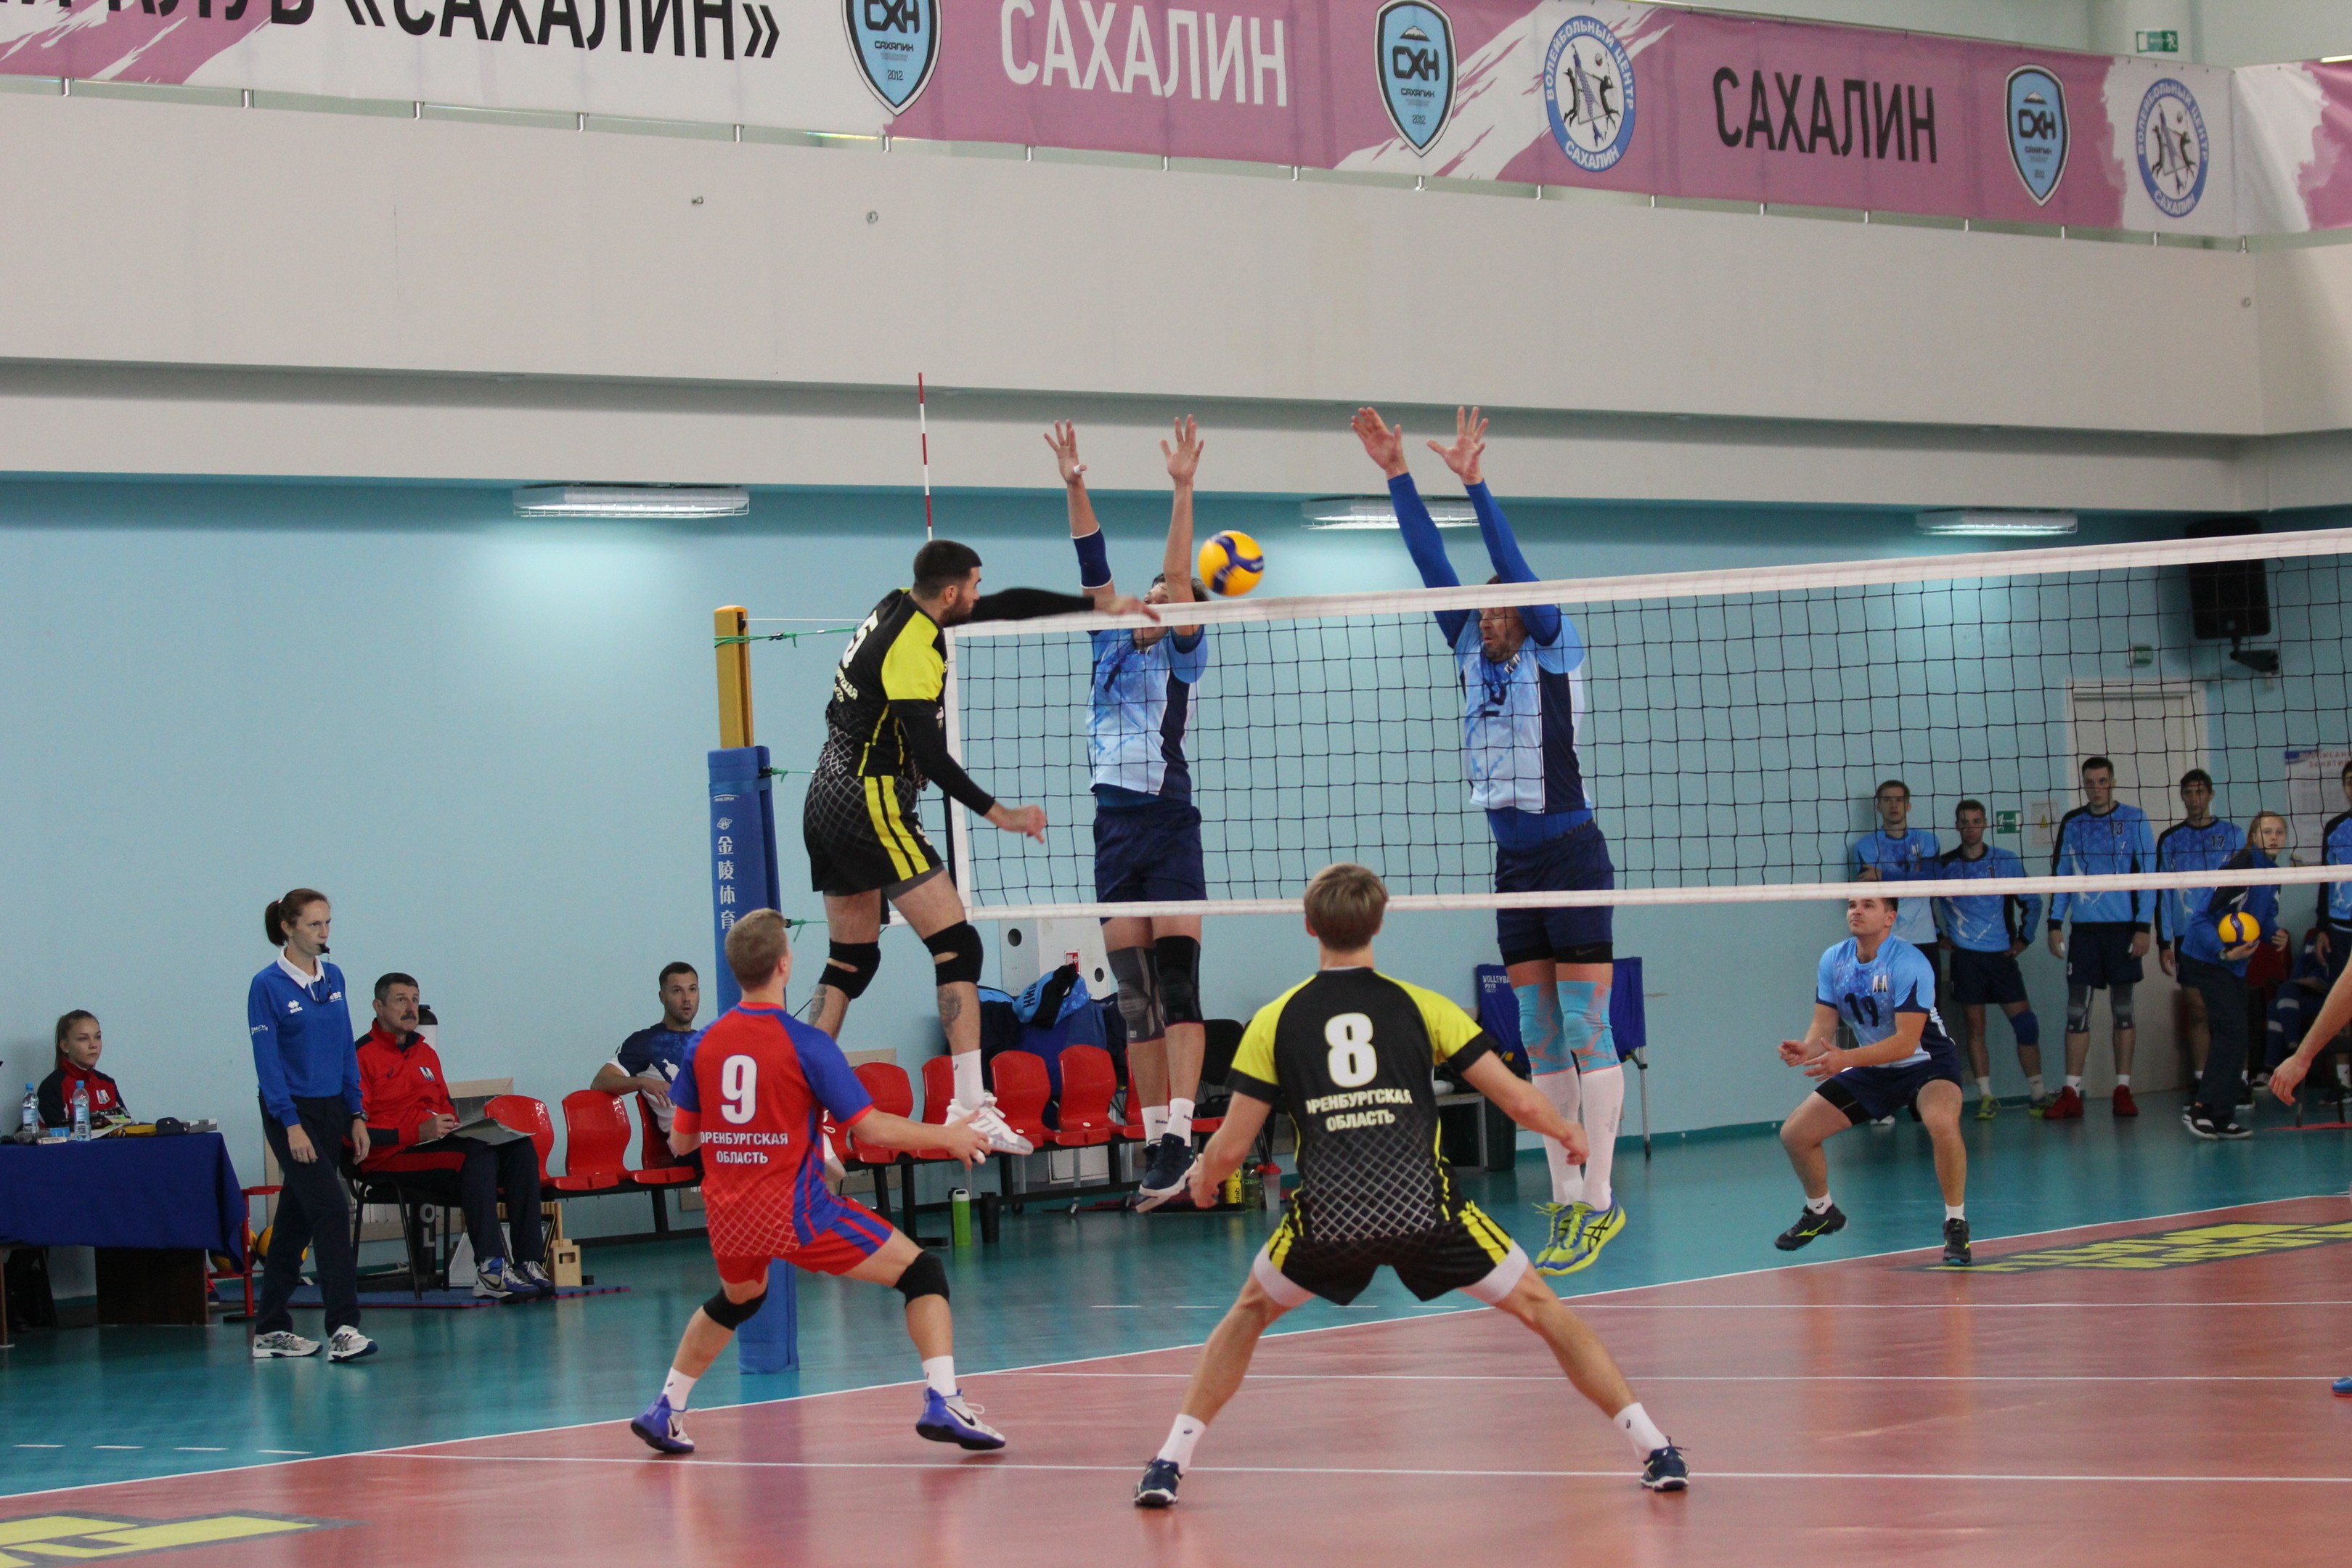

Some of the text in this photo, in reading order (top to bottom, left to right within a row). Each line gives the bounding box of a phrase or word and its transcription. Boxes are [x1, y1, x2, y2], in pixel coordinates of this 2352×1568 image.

[874, 41, 914, 52] САХАЛИН
[1001, 0, 1287, 107] САХАЛИН
[887, 70, 904, 81] 2012
[1392, 45, 1440, 81] СХН
[1545, 20, 1633, 110] ВОЛЕЙБОЛЬНЫЙ ЦЕНТР
[1401, 87, 1435, 98] САХАЛИН
[1412, 114, 1426, 125] 2012
[1713, 67, 1937, 164] САХАЛИН
[2018, 109, 2057, 140] СХН
[1565, 140, 1620, 168] САХАЛИН
[2154, 190, 2196, 213] САХАЛИН
[718, 836, 736, 929] 金陵体育
[1844, 992, 1879, 1027] 19
[1324, 1012, 1378, 1088] 8
[721, 1054, 758, 1124] 9
[1326, 1109, 1396, 1132] ОБЛАСТЬ
[716, 1151, 769, 1164] ОБЛАСТЬ
